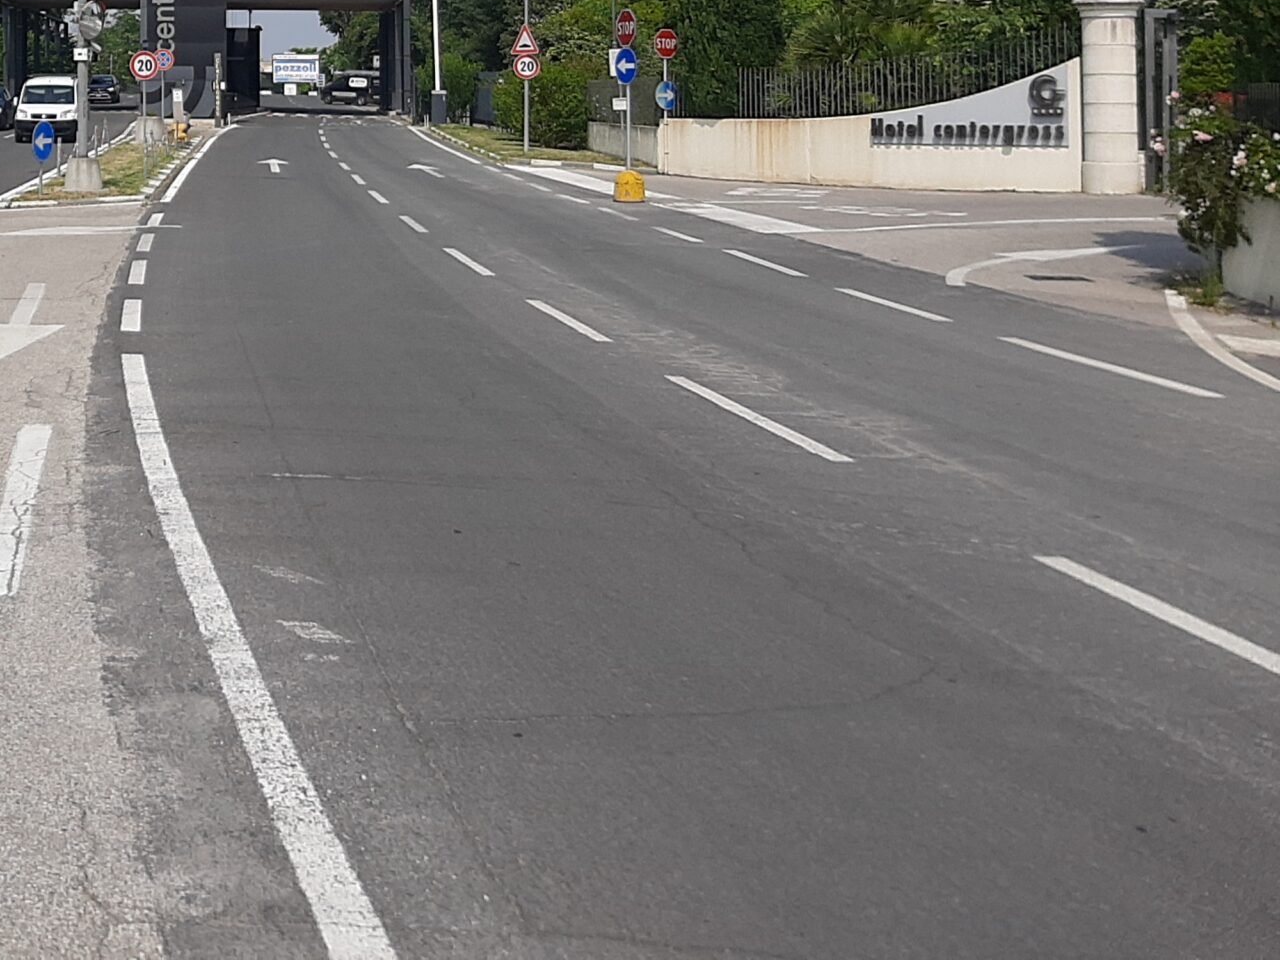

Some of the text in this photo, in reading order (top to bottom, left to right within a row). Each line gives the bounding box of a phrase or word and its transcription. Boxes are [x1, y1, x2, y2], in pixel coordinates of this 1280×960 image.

[618, 21, 634, 35] STOP
[656, 38, 676, 50] STOP
[137, 59, 153, 72] 20
[520, 60, 534, 72] 20
[871, 114, 1065, 146] Hotel centergross
